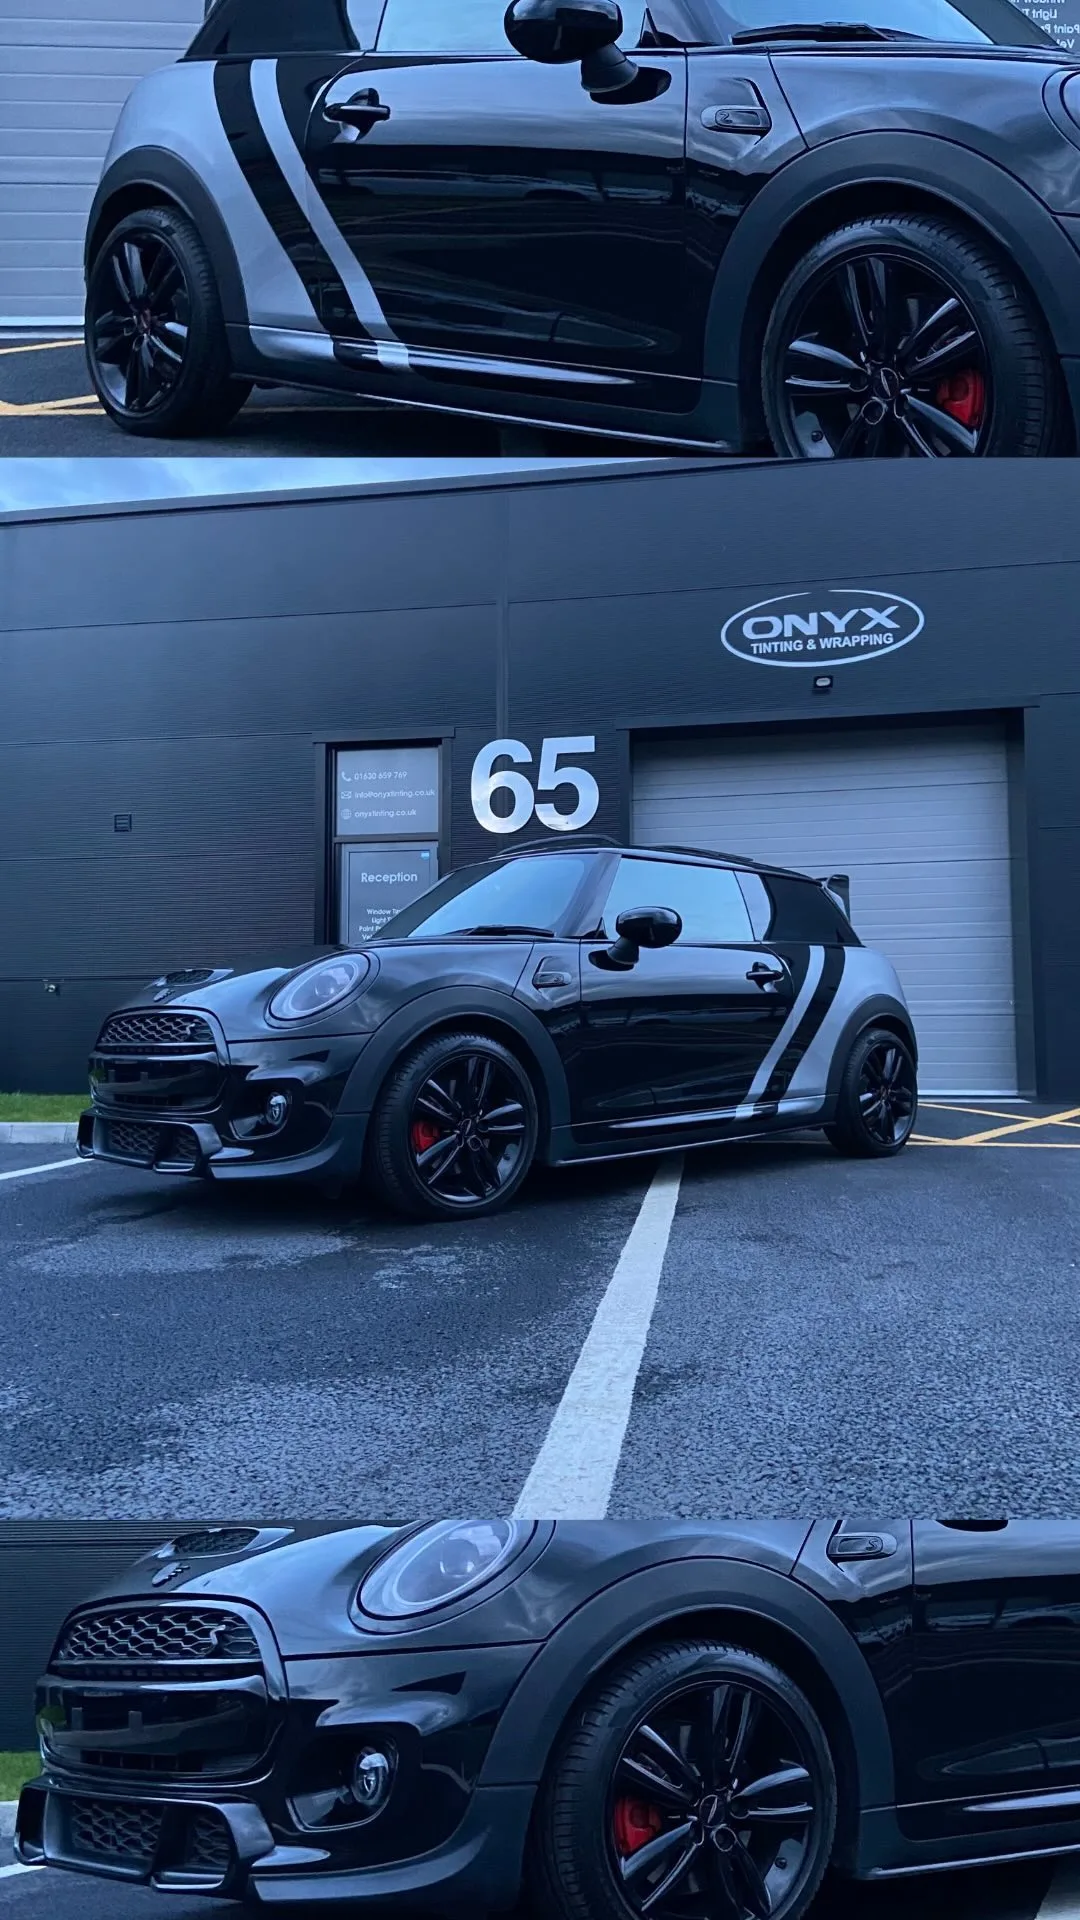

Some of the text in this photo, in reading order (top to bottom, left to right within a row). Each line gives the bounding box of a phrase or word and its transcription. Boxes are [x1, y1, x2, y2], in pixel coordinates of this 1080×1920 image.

[742, 605, 901, 640] ONYX
[750, 632, 894, 655] TINTING & WRAPPING
[471, 735, 600, 834] 65
[354, 788, 436, 800] info@onyxtinting.co.uk
[354, 808, 417, 819] onyxtinting.co.uk
[361, 871, 418, 884] Reception
